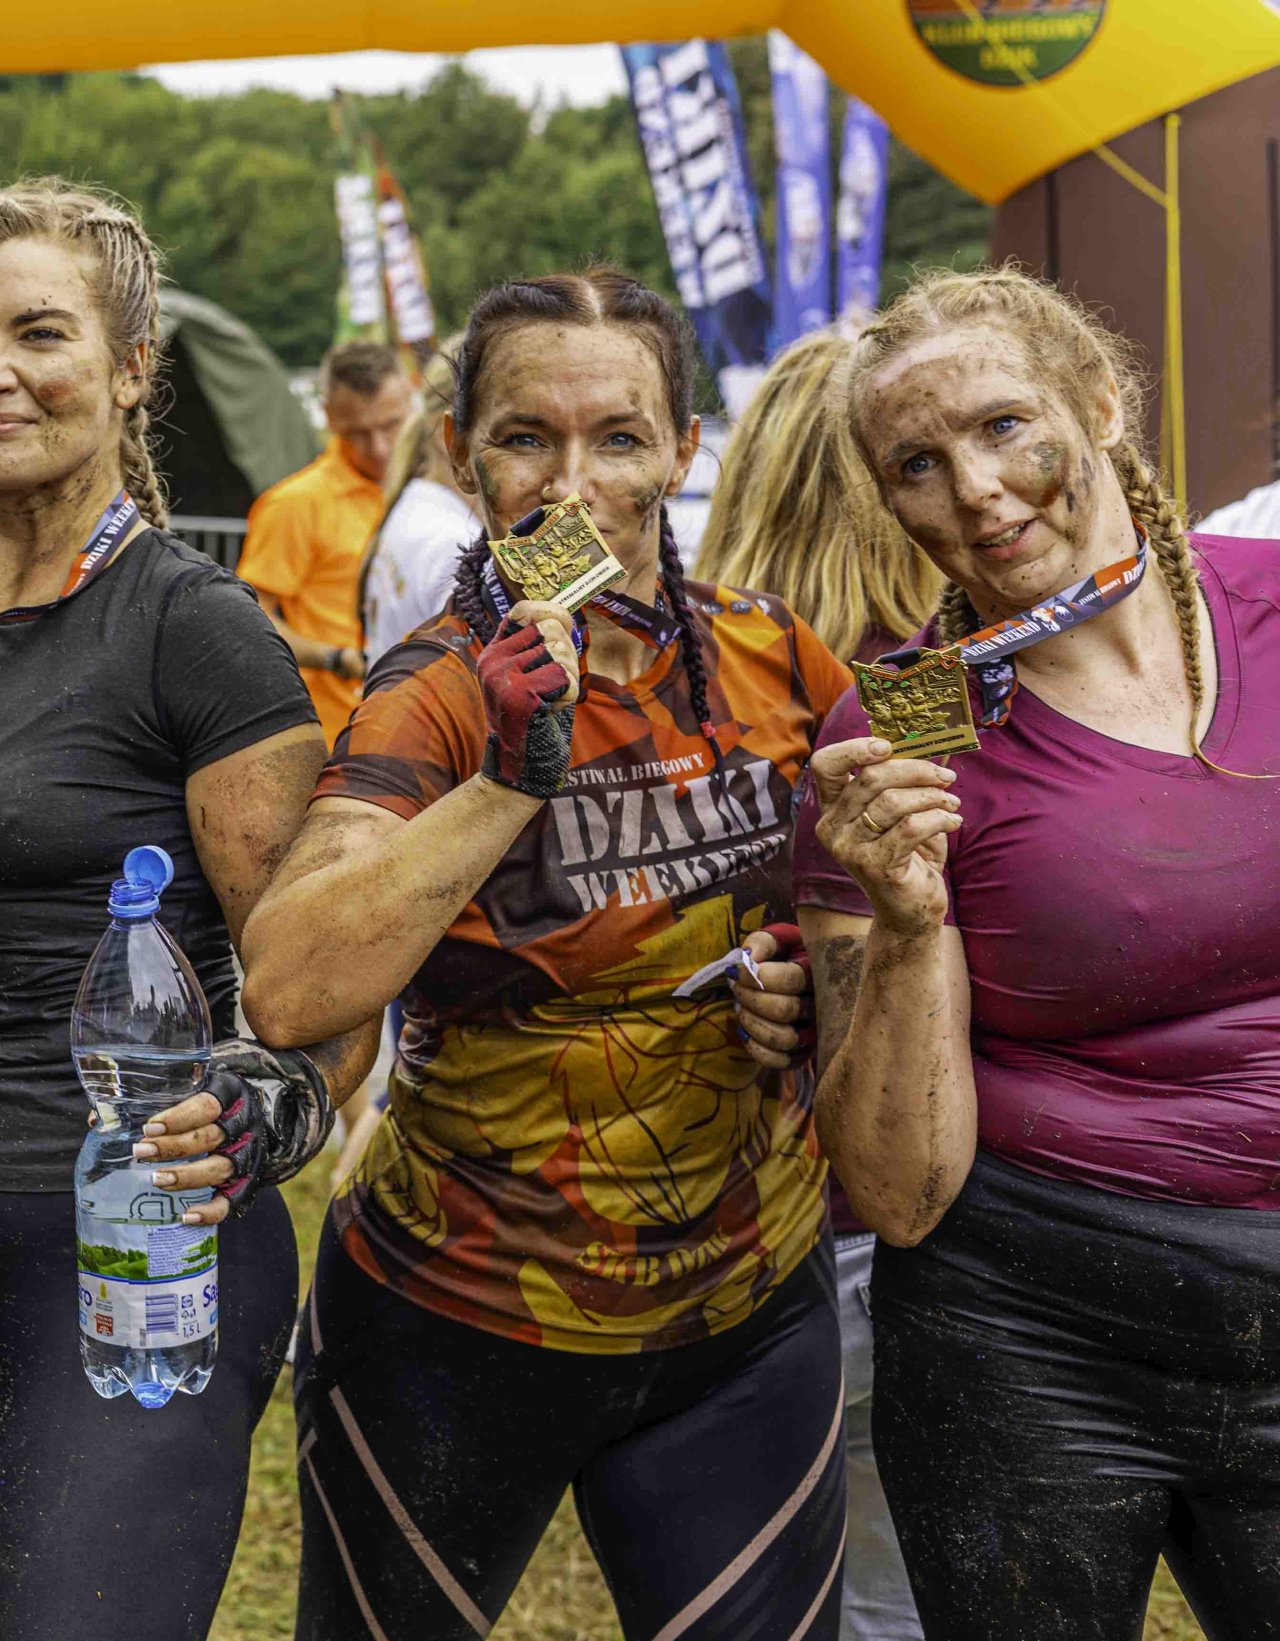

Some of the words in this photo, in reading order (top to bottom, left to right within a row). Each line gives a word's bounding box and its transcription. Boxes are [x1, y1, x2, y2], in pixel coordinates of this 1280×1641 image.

[966, 639, 998, 658] DZIKI
[992, 620, 1042, 648] WEEKEND
[564, 766, 629, 788] STIWAL
[631, 752, 705, 781] BIEGOWY
[550, 760, 779, 866] DZIKI
